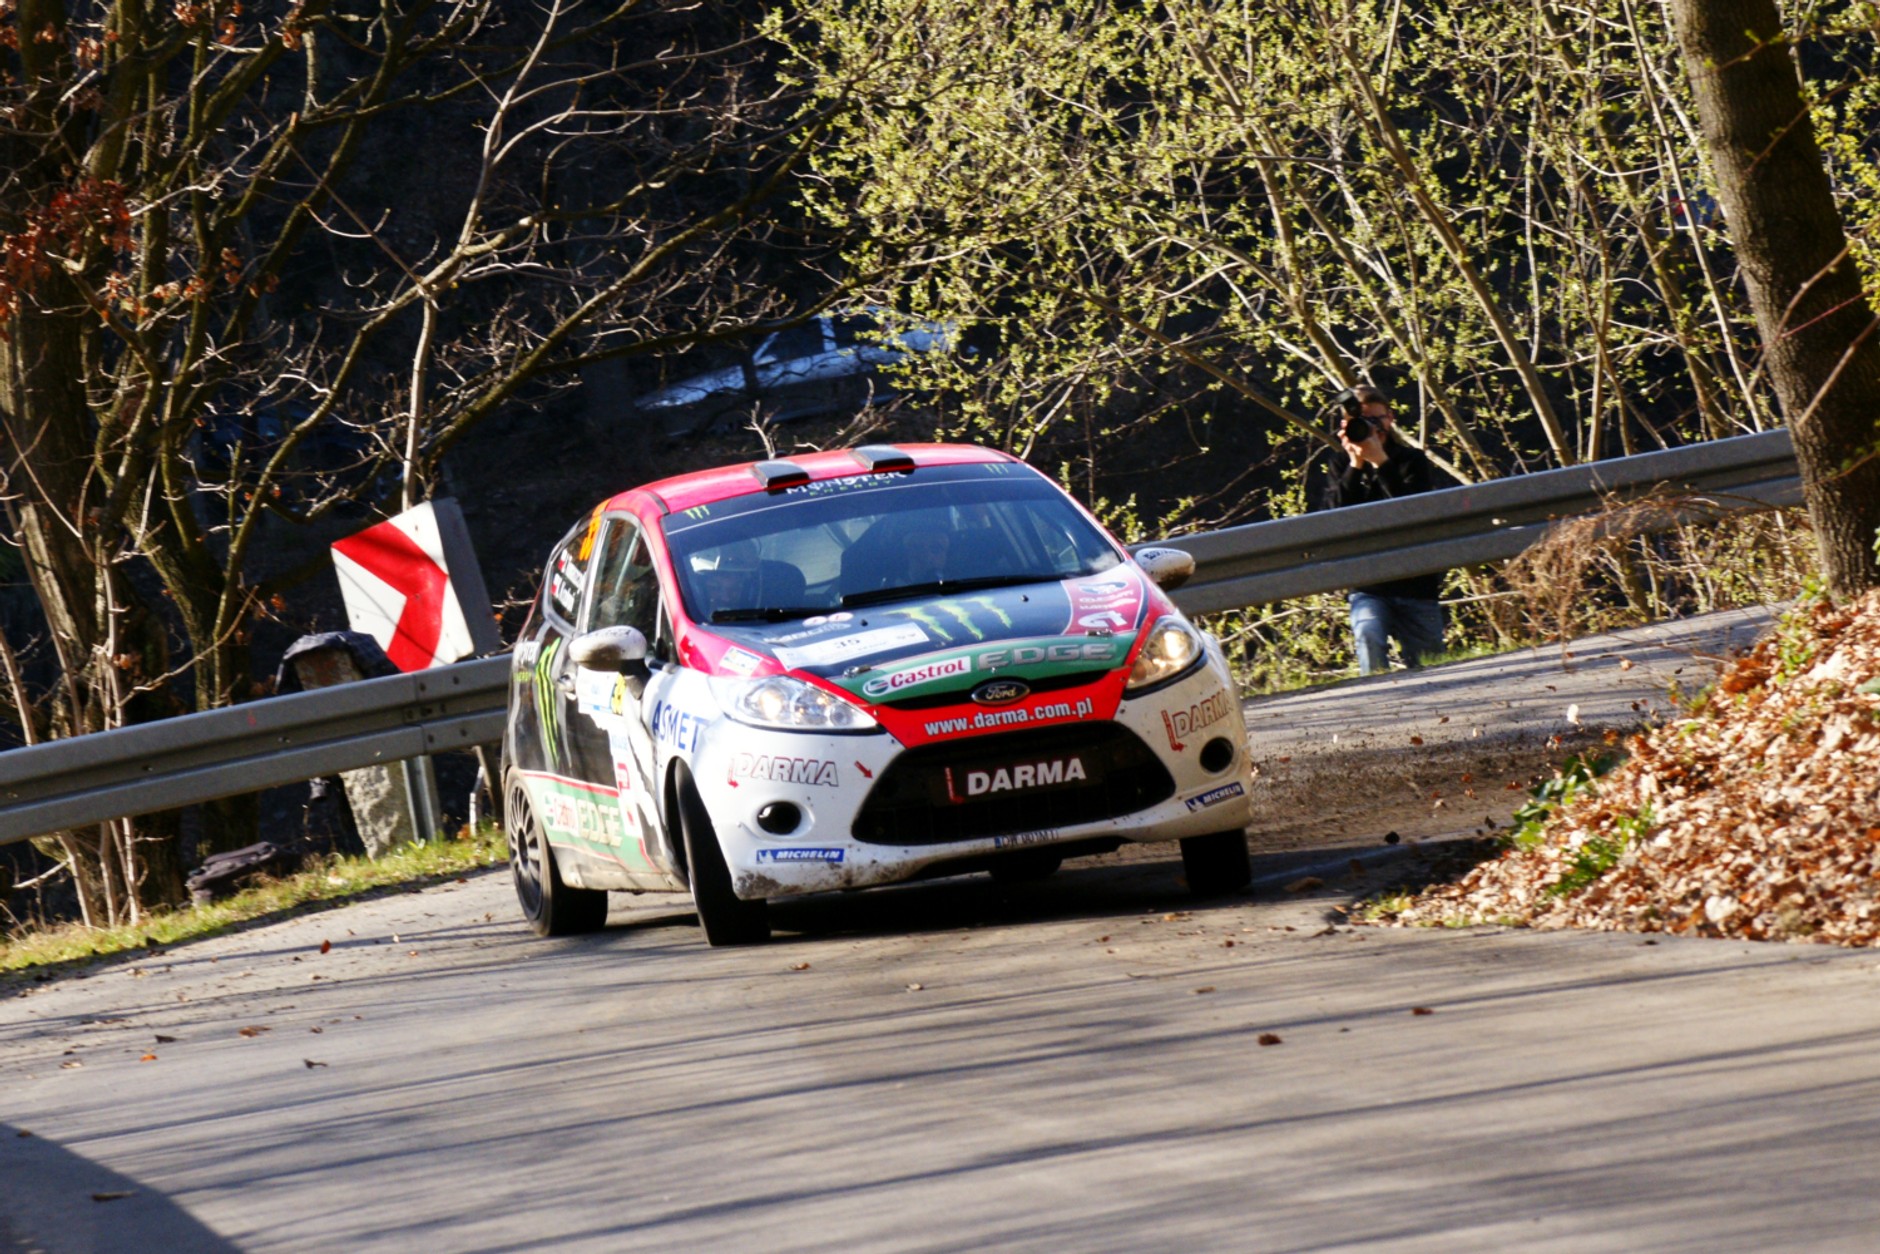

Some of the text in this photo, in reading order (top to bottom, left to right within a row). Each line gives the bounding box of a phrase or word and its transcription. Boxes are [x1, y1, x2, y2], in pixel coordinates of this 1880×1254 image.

[890, 642, 1113, 689] Castrol EDGE
[985, 685, 1017, 700] Ford
[652, 699, 711, 754] ASMET
[924, 697, 1093, 736] www.darma.com.pl
[735, 752, 839, 788] DARMA
[967, 757, 1087, 797] DARMA
[1201, 784, 1241, 804] MICHELIN
[577, 798, 623, 849] EDGE
[775, 849, 841, 860] MICHELIN
